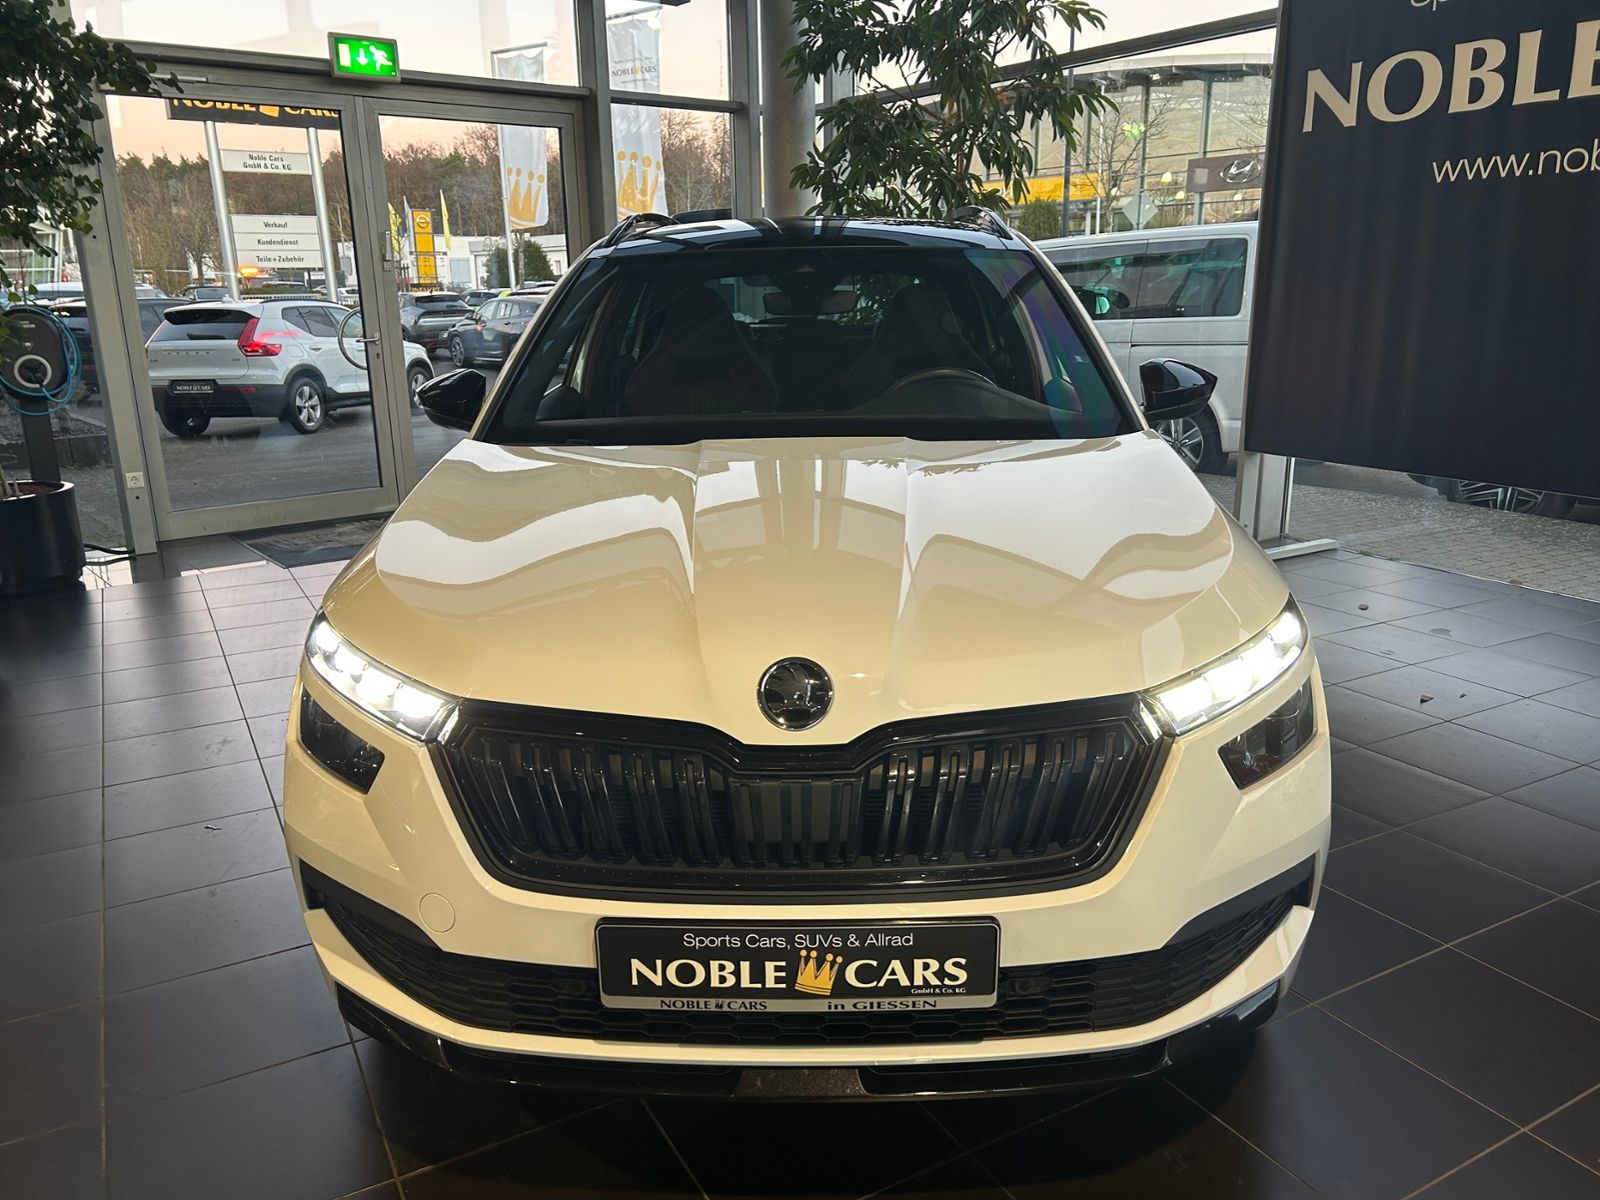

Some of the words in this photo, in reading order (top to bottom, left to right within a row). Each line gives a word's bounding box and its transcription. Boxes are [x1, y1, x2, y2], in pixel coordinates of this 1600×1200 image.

[611, 67, 636, 77] NOBLE
[1302, 19, 1600, 133] NOBLE
[249, 154, 267, 162] Noble
[257, 238, 299, 246] Kundendienst
[683, 933, 741, 949] Sports
[745, 934, 791, 950] Cars,
[794, 933, 843, 948] SUVs
[847, 933, 861, 947] &
[865, 933, 914, 947] Allrad
[630, 958, 787, 988] NOBLE
[844, 957, 968, 988] CARS
[660, 999, 712, 1010] NOBLE
[727, 1000, 768, 1010] CARS
[827, 1001, 845, 1010] in
[852, 1000, 937, 1010] GIESSEN
